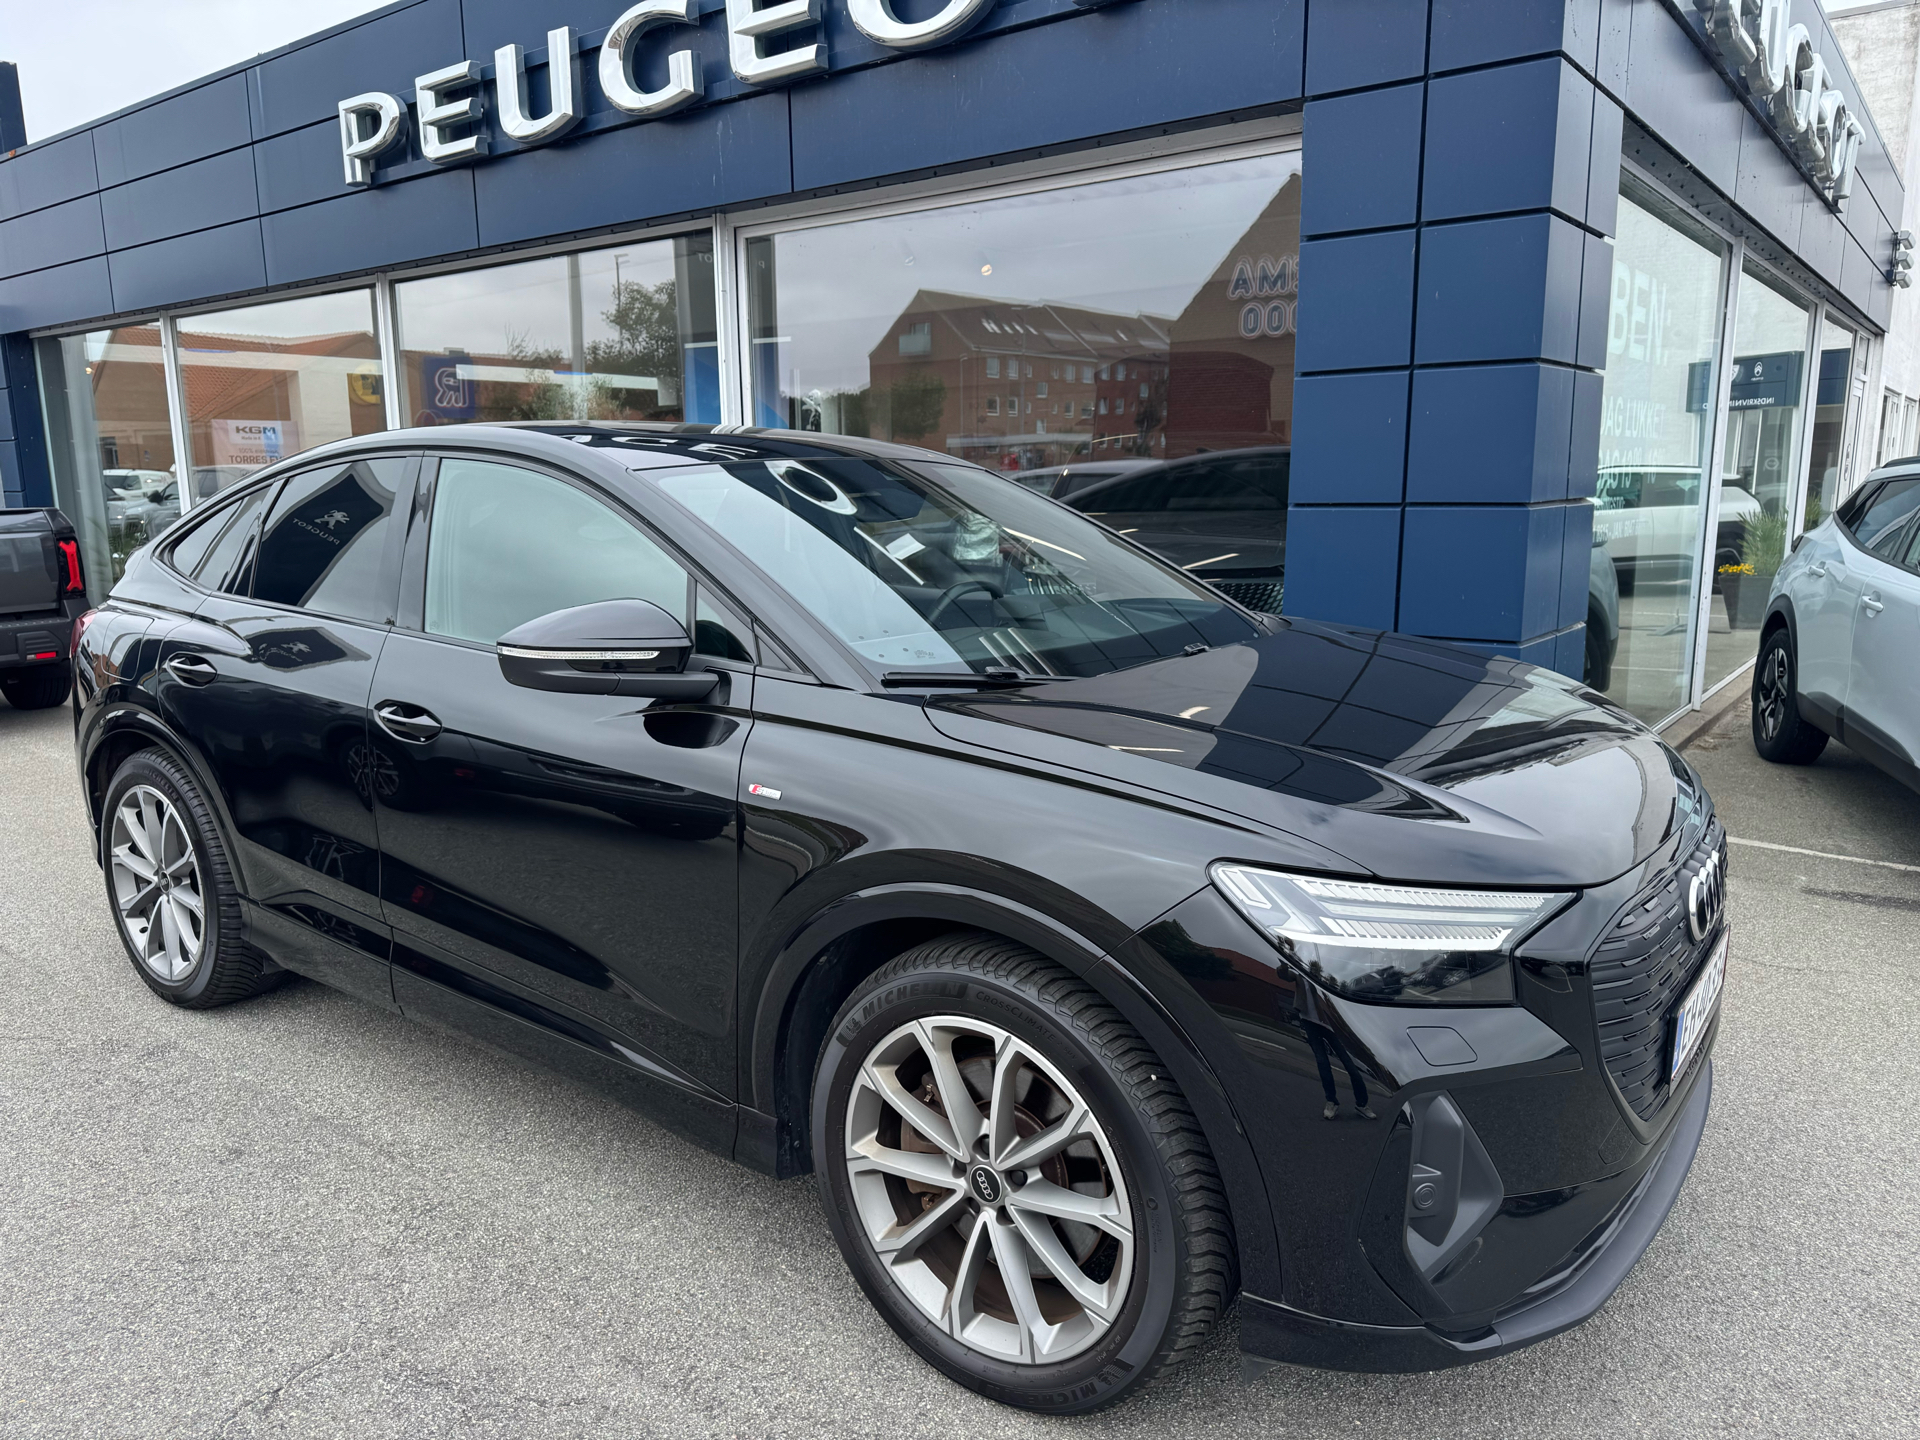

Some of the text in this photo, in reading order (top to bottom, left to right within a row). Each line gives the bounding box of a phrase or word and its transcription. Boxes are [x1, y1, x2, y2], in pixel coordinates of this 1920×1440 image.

[235, 425, 276, 434] KGM
[1625, 398, 1667, 440] LUKKET
[229, 455, 268, 464] TORRES
[862, 981, 959, 1020] MICHELIN
